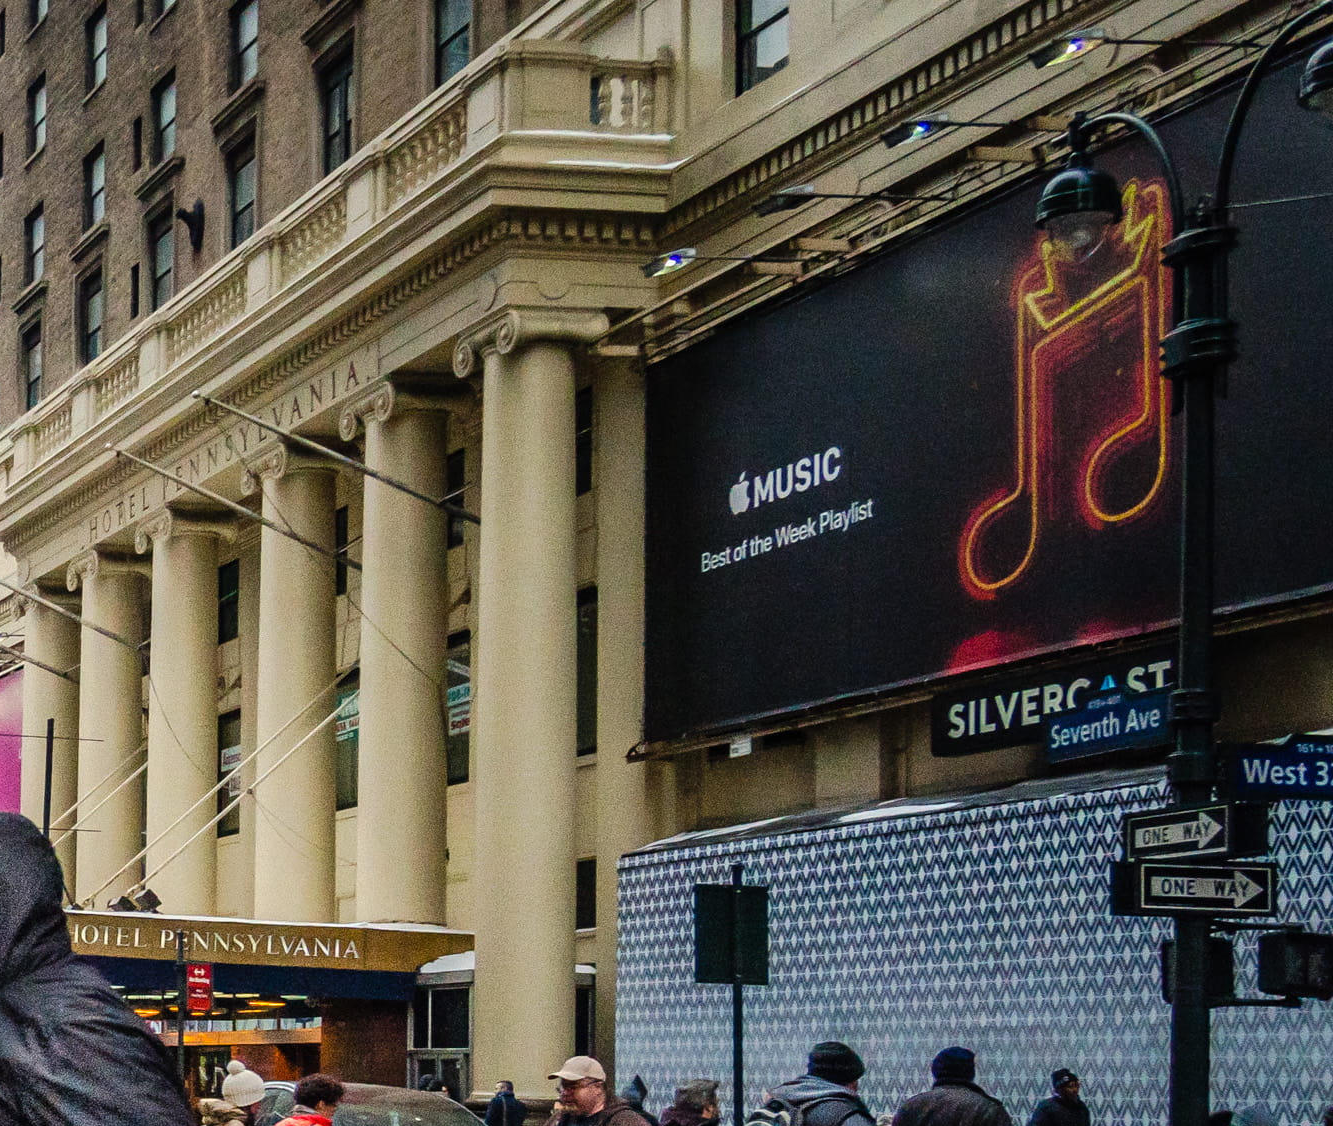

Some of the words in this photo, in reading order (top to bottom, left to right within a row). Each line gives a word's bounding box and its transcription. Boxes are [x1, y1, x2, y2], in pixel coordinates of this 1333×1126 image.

[753, 446, 841, 508] MUSIC
[88, 486, 149, 543] HOTEL
[700, 546, 732, 573] Best
[733, 539, 748, 562] of
[749, 533, 773, 557] the
[774, 517, 817, 549] Week
[819, 498, 874, 535] Playlist
[1050, 711, 1120, 749] Seventh
[1124, 707, 1161, 733] Ave
[1243, 758, 1308, 786] West
[1315, 761, 1333, 787] 3
[1142, 827, 1170, 846] ONE
[1183, 821, 1212, 841] WAY
[1160, 878, 1197, 895] ONE
[1213, 879, 1250, 898] WAY
[160, 928, 360, 959] PENNSYLVANIA
